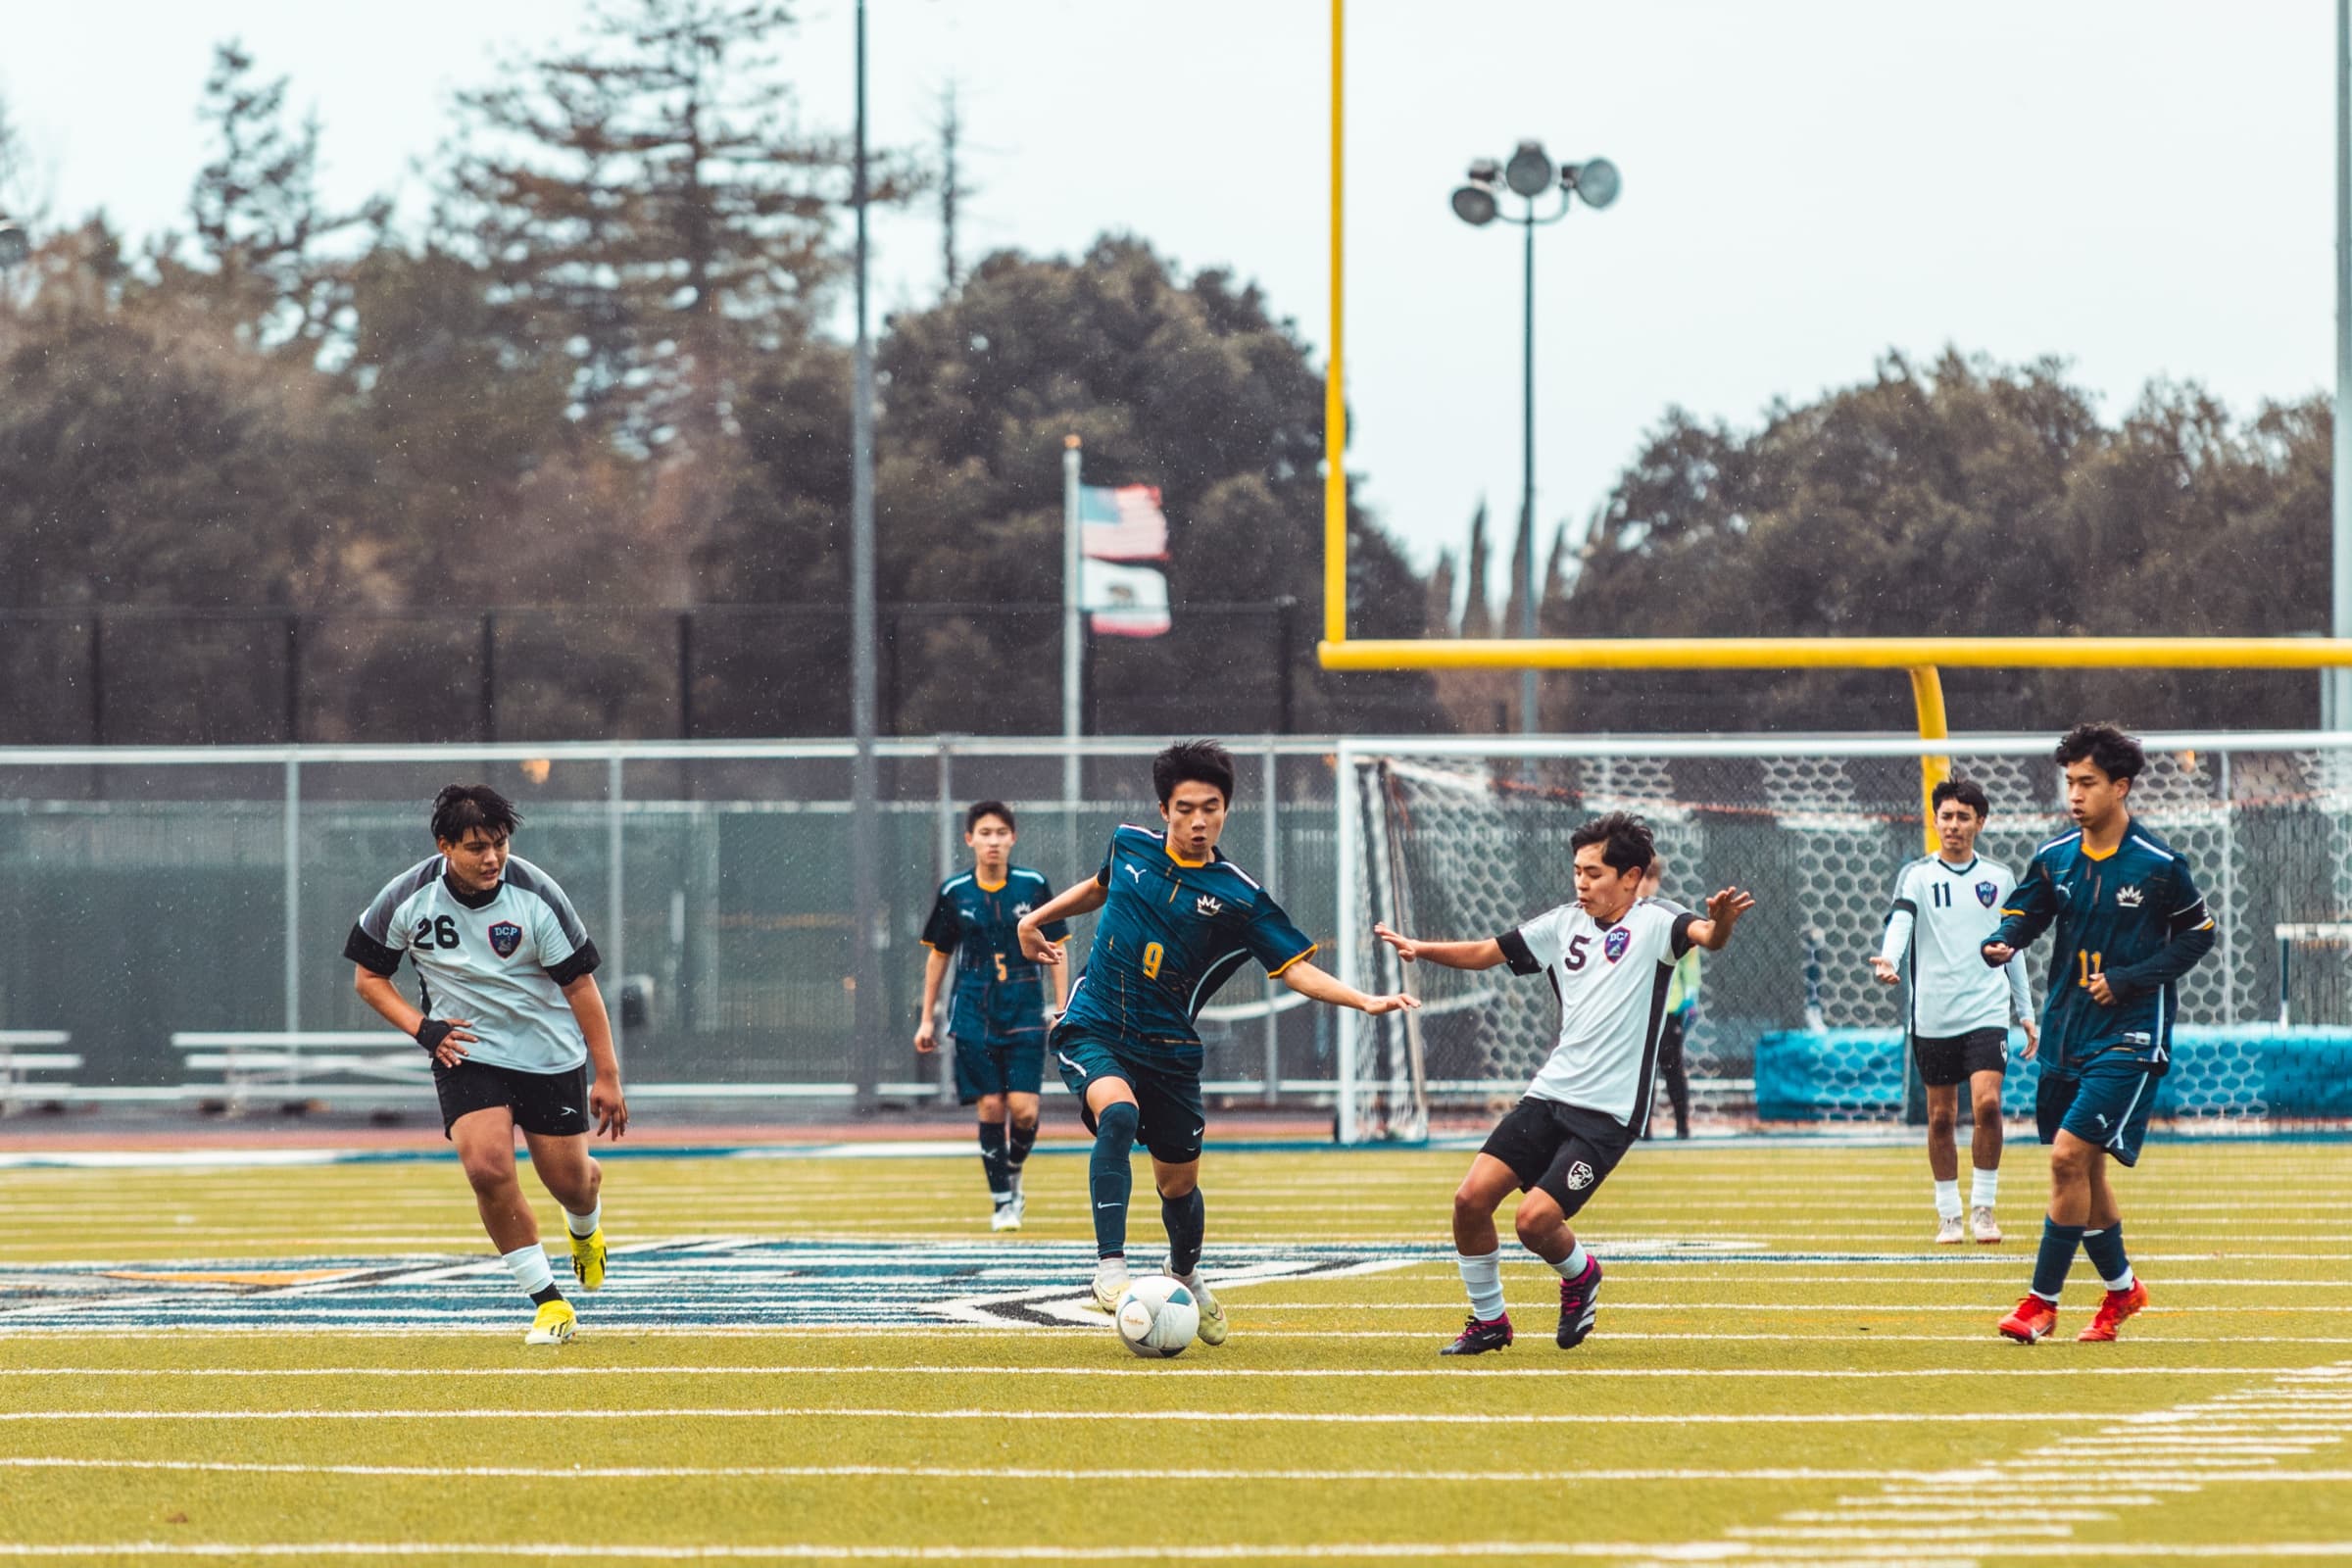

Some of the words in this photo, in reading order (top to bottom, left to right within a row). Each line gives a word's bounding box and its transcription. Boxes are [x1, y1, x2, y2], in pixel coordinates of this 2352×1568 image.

[1932, 882, 1951, 907] 11
[414, 915, 460, 950] 26
[495, 927, 517, 936] DCP
[994, 954, 1006, 981] 5
[1143, 942, 1164, 980] 9
[1565, 934, 1592, 971] 5
